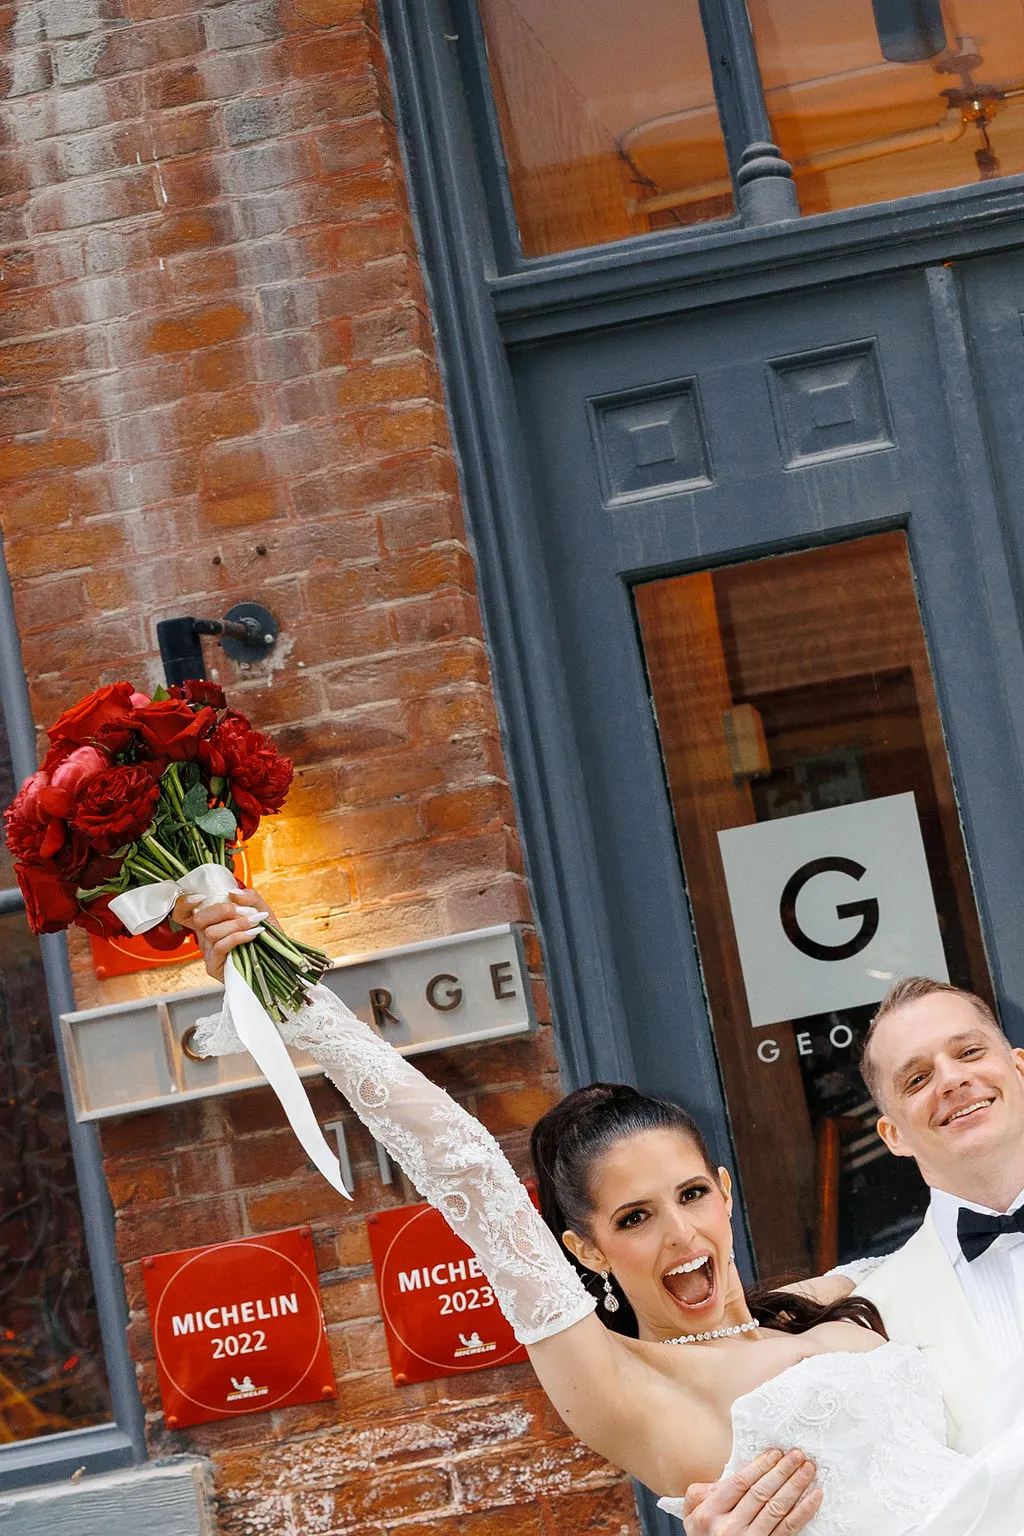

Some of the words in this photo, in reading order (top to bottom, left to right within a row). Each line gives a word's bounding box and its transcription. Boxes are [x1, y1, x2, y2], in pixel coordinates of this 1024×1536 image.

[780, 856, 880, 961] G
[181, 960, 517, 1062] GRGE
[757, 1018, 874, 1063] GEO
[397, 1257, 484, 1293] MICHE
[171, 1293, 299, 1337] MICHELIN
[438, 1286, 495, 1316] 2023
[210, 1330, 268, 1360] 2022
[453, 1343, 497, 1358] MICHELIN
